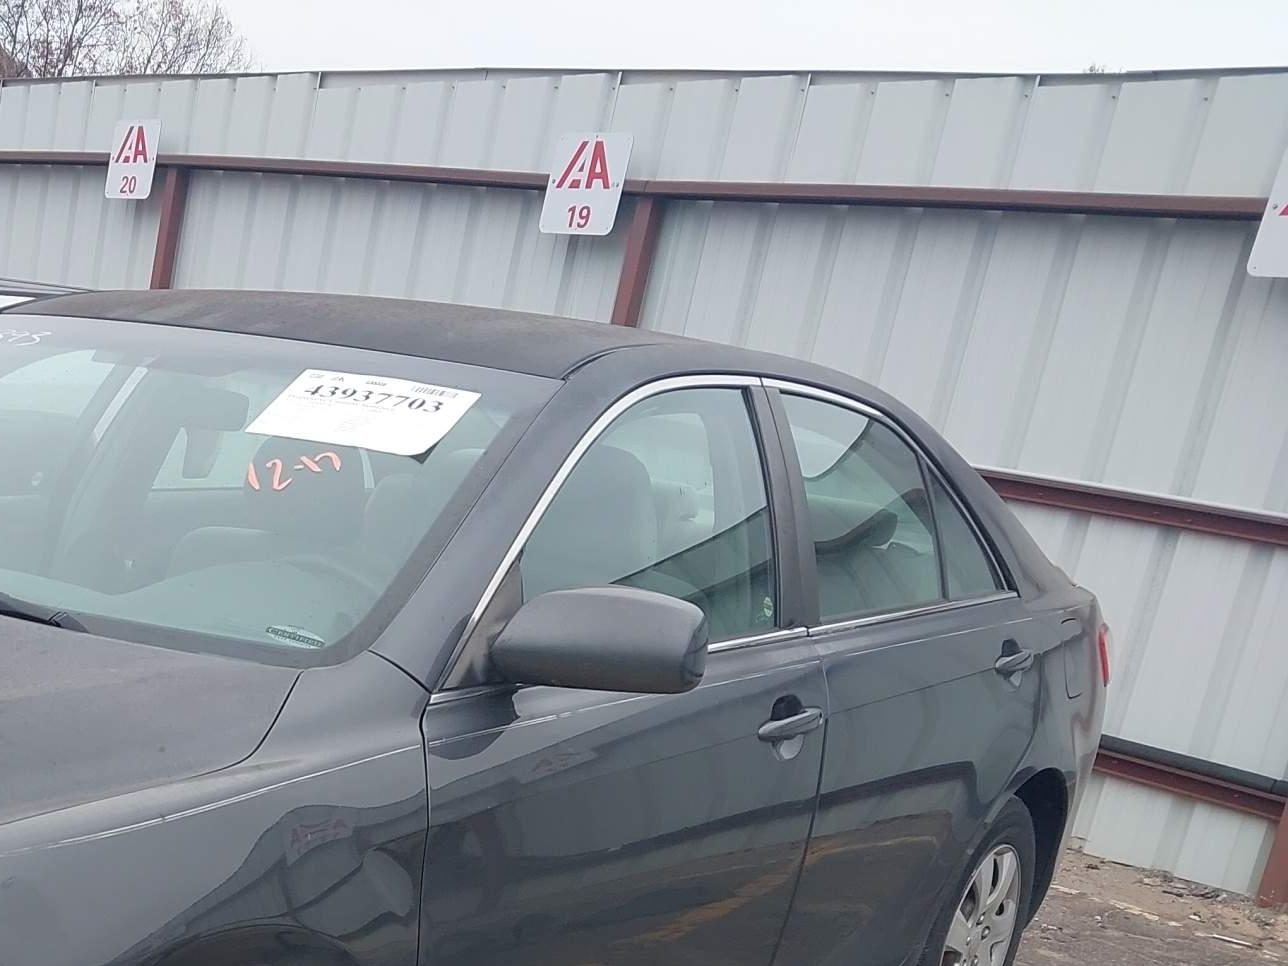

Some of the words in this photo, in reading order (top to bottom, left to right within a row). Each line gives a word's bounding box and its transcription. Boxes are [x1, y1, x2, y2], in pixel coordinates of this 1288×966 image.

[120, 175, 137, 193] 20
[567, 205, 591, 228] 19
[304, 384, 444, 413] 43937703
